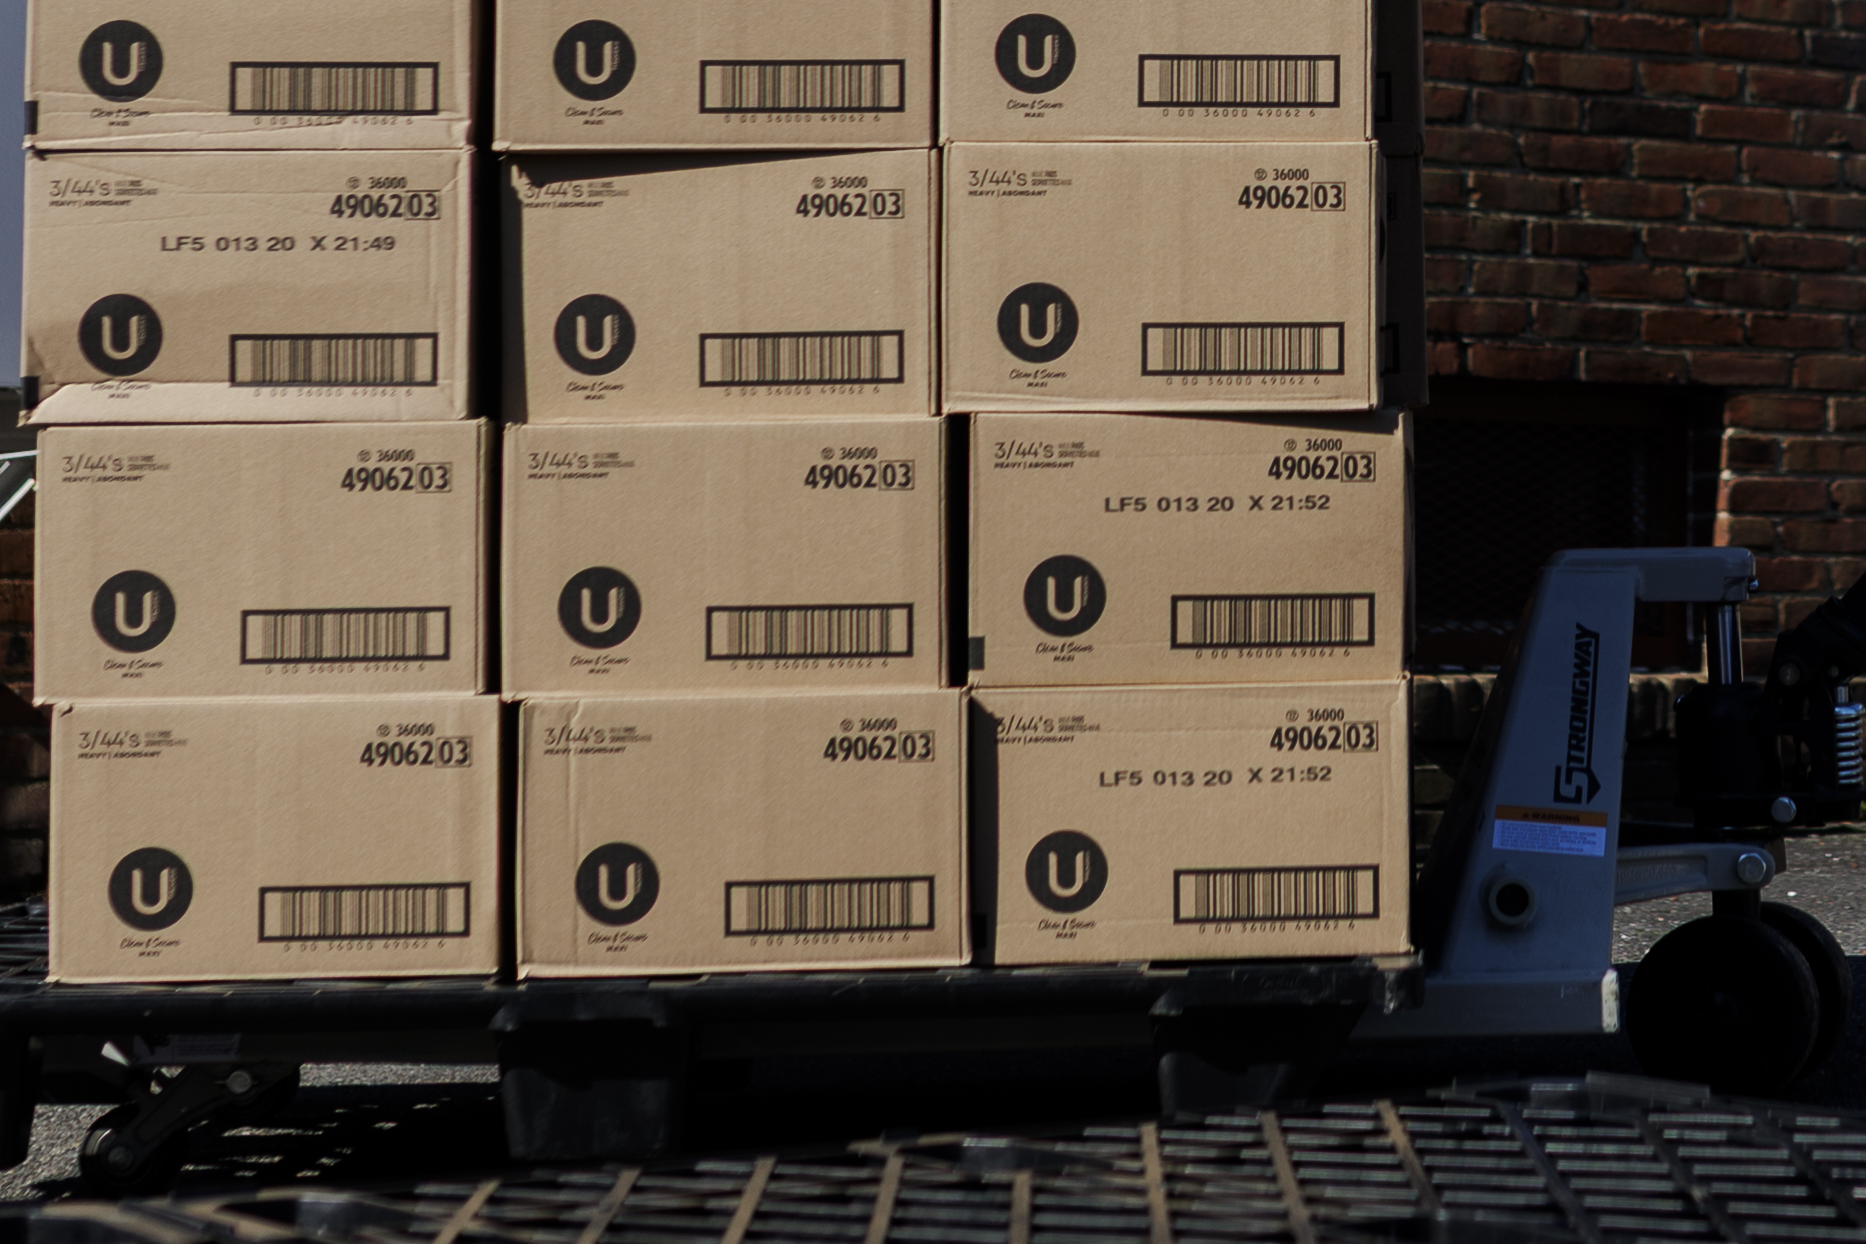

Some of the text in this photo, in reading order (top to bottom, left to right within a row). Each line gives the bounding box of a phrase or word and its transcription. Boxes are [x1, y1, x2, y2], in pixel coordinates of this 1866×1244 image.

[103, 41, 140, 85] U
[576, 40, 612, 84] U
[1017, 34, 1052, 77] U
[369, 177, 407, 189] 36000
[831, 176, 868, 189] 36000
[1273, 168, 1309, 181] 36000
[161, 236, 395, 252] LF5 013 20 X 21:49
[103, 315, 140, 359] U
[576, 315, 612, 359] U
[1020, 303, 1055, 347] U
[377, 449, 414, 462] 36000
[840, 447, 878, 460] 36000
[1306, 438, 1342, 452] 36000
[1105, 494, 1330, 512] LF5 013 20 X 21:52
[115, 591, 151, 637] U
[581, 587, 617, 632] U
[1047, 576, 1083, 621] U
[397, 723, 435, 737] 36000
[859, 718, 897, 732] 36000
[1308, 708, 1344, 722] 36000
[1554, 622, 1600, 804] STRONGWAY
[1099, 766, 1331, 787] LF5 013 20 X 21:52
[131, 868, 168, 915] U
[598, 863, 635, 910] U
[1048, 851, 1085, 897] U
